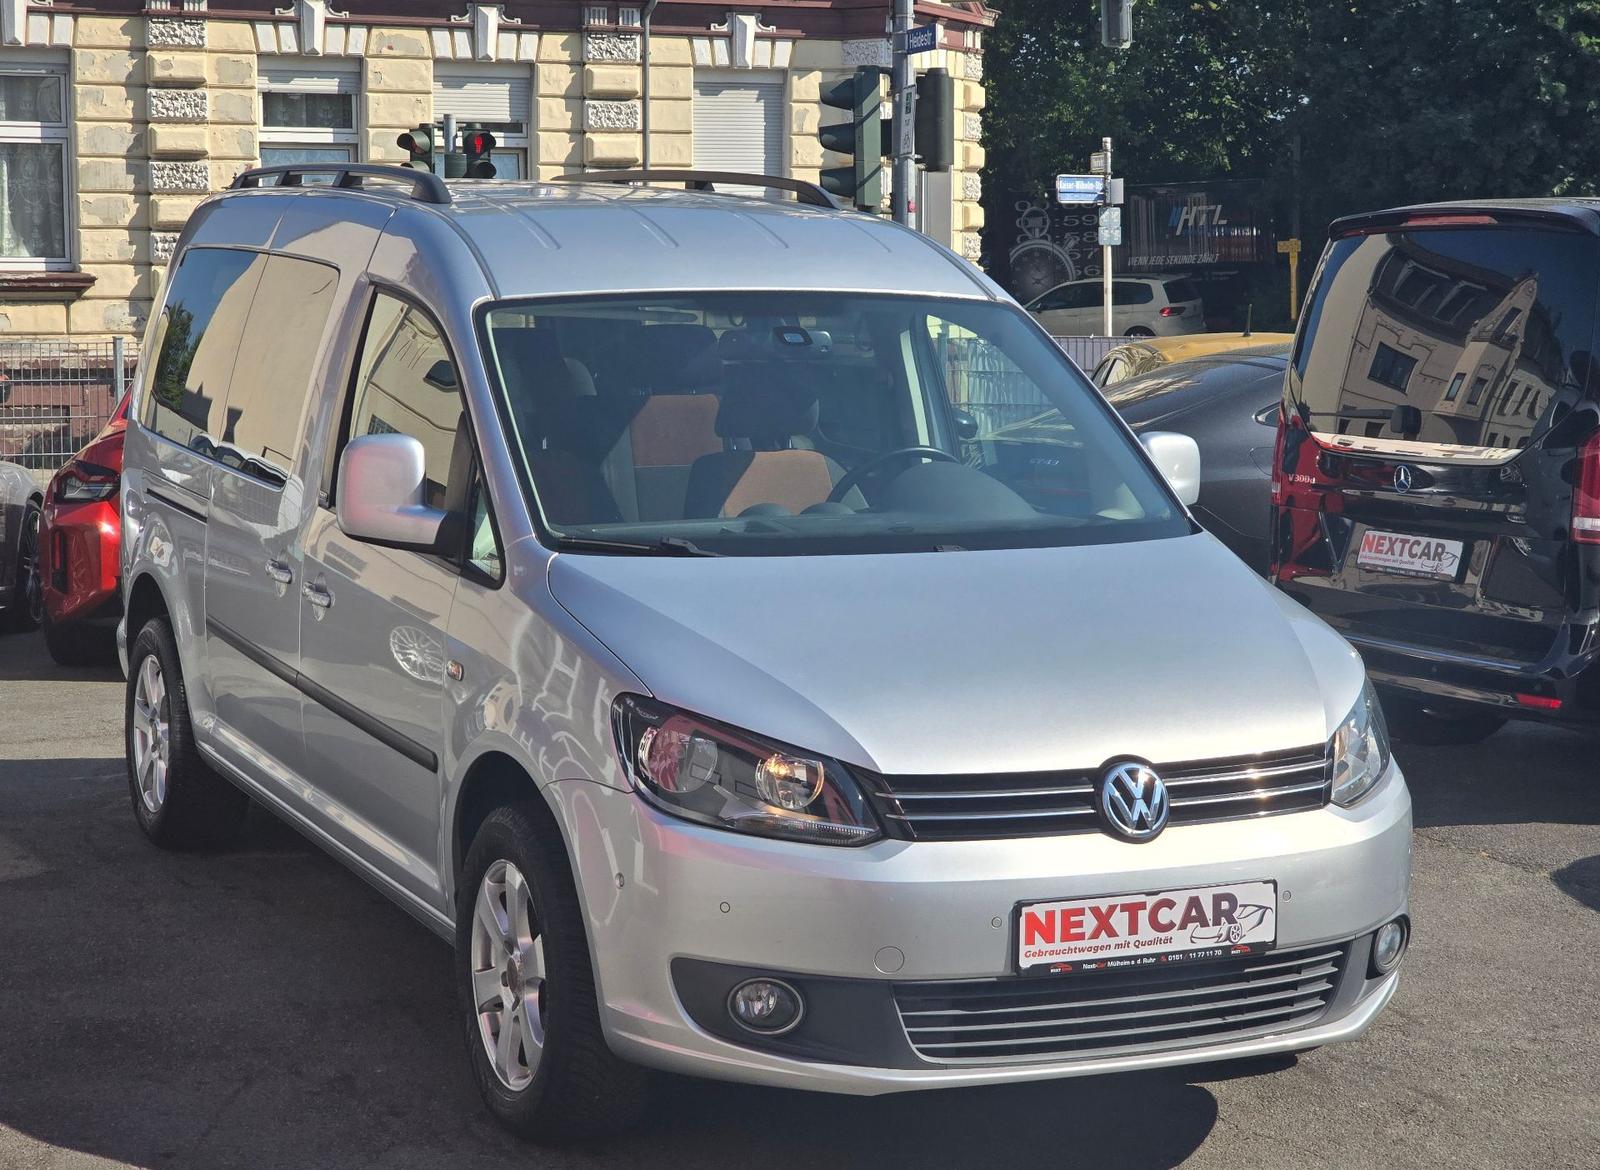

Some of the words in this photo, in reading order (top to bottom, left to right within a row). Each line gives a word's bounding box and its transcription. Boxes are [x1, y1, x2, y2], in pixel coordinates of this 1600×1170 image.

[909, 30, 934, 49] Heidestr.
[1176, 205, 1228, 236] HTL
[1148, 255, 1165, 266] JEDE
[1166, 254, 1198, 265] SEKUNDE
[1197, 252, 1220, 264] ZÄHLT
[1288, 473, 1316, 484] V300d
[1361, 534, 1446, 562] NEXTCAR
[1104, 763, 1168, 835] VW
[1024, 892, 1239, 946] NEXTCAR
[1024, 943, 1111, 958] Gebrauchtwagen
[1114, 940, 1131, 950] mit
[1133, 936, 1173, 948] Qualität
[1107, 959, 1131, 968] Mülheim
